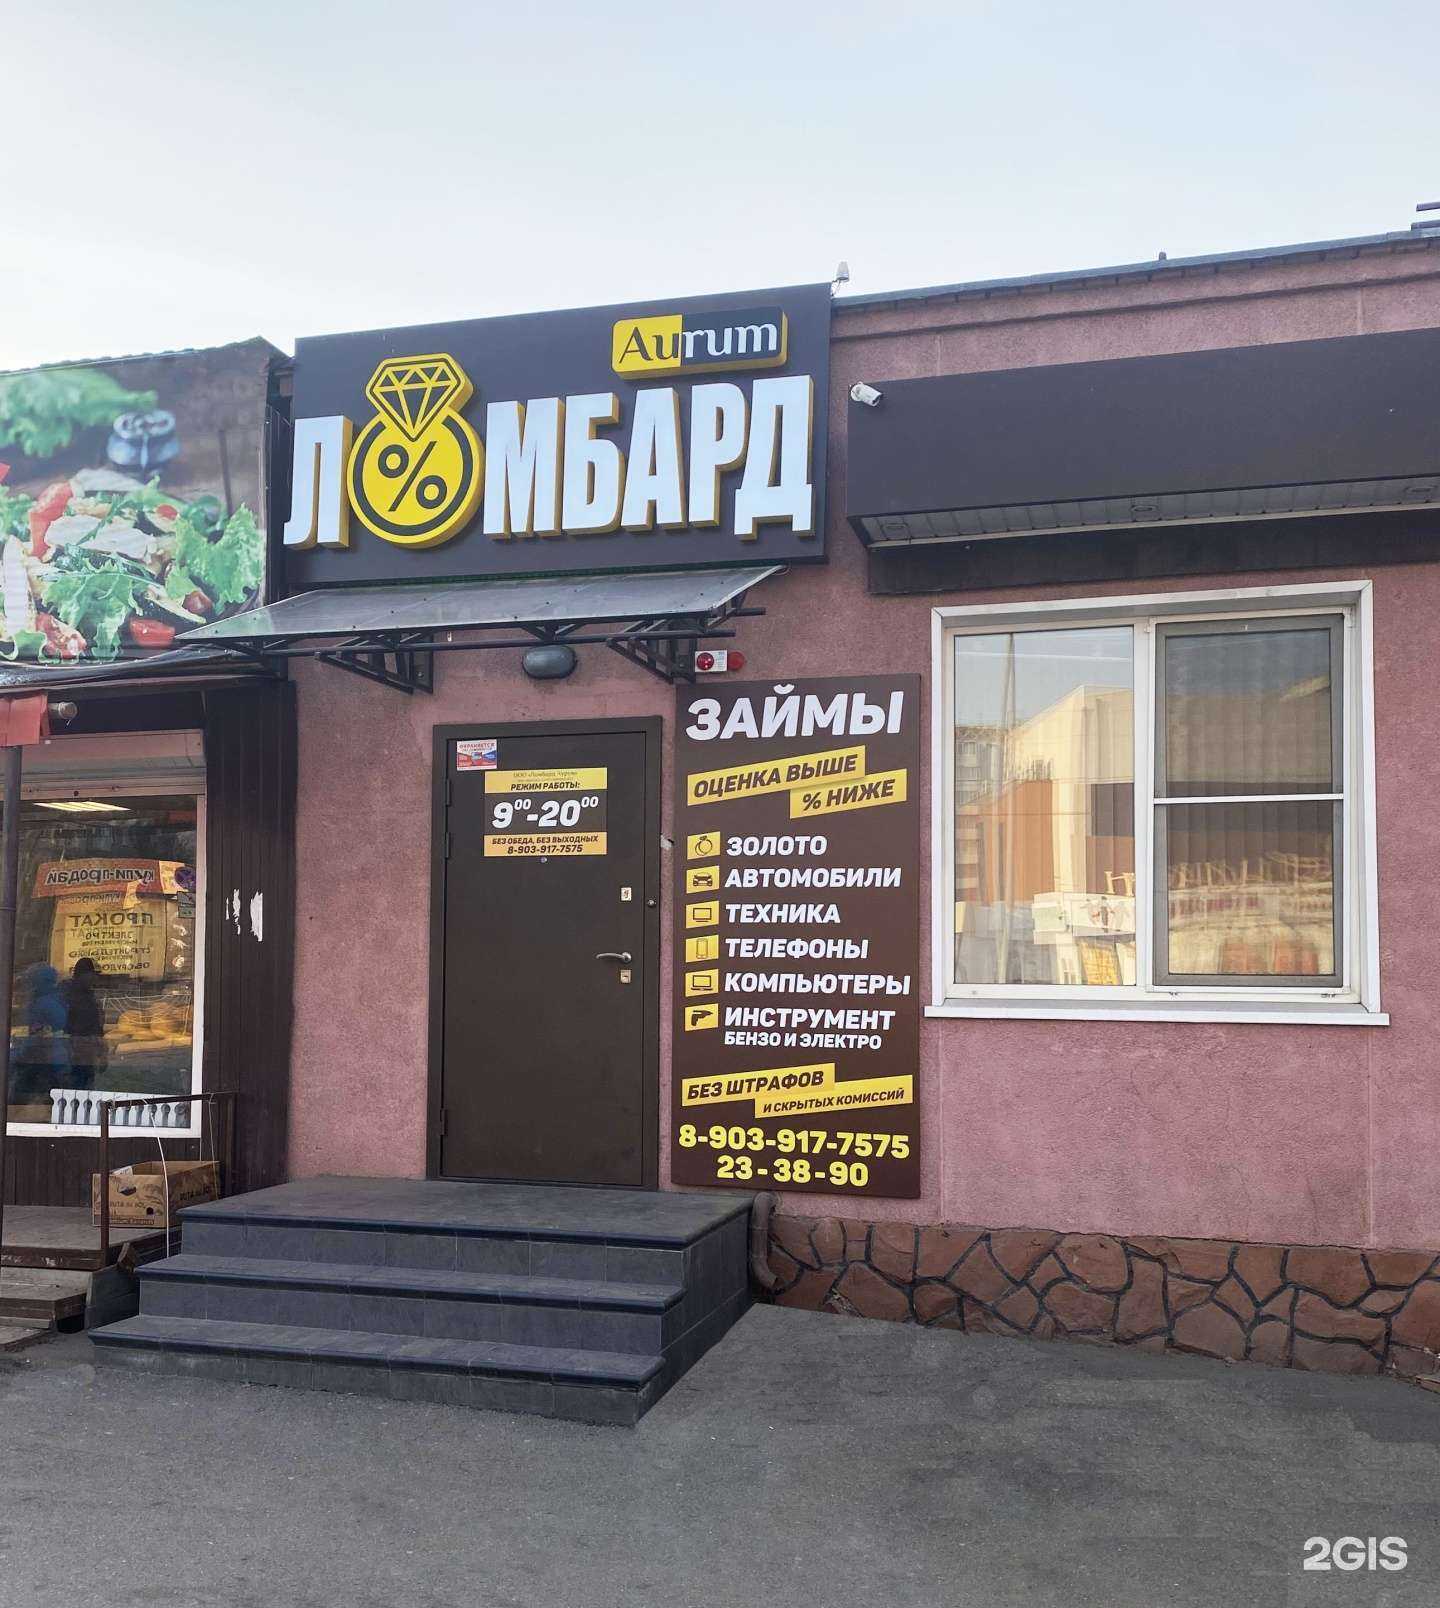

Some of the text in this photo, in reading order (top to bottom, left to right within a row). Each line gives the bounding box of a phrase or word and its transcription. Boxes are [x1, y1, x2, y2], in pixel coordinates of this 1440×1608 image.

[618, 321, 778, 364] Aurum
[282, 372, 814, 549] ЛОМБАРД
[686, 683, 904, 740] ЗАЙМЫ
[511, 781, 580, 791] РЕЖИМ РАБОТЫ:
[694, 754, 858, 799] ОЦЕНКА ВЫШЕ
[802, 778, 896, 811] % НИЖЕ
[507, 844, 583, 854] 8-903-917-7575
[536, 836, 551, 844] БЕЗ
[552, 835, 598, 844] ВЫХОДНЫХ
[726, 835, 828, 856] ЗОЛОТО
[724, 867, 902, 888] АВТОМОБИЛИ
[725, 904, 841, 924] ТЕХНИКА
[725, 938, 868, 959] ТЕЛЕФОНЫ
[724, 972, 911, 995] КОМПЬЮТЕРЫ
[724, 1007, 896, 1030] ИНСТРУМЕНТ
[724, 1031, 882, 1050] БЕНЗО И ЭЛЕКТРО
[687, 1070, 824, 1100] БЕЗ ШТРАФОВ
[763, 1087, 904, 1113] И СКРЫТЫХ КОМИССИЙ
[678, 1124, 910, 1159] 8-903-917-7575
